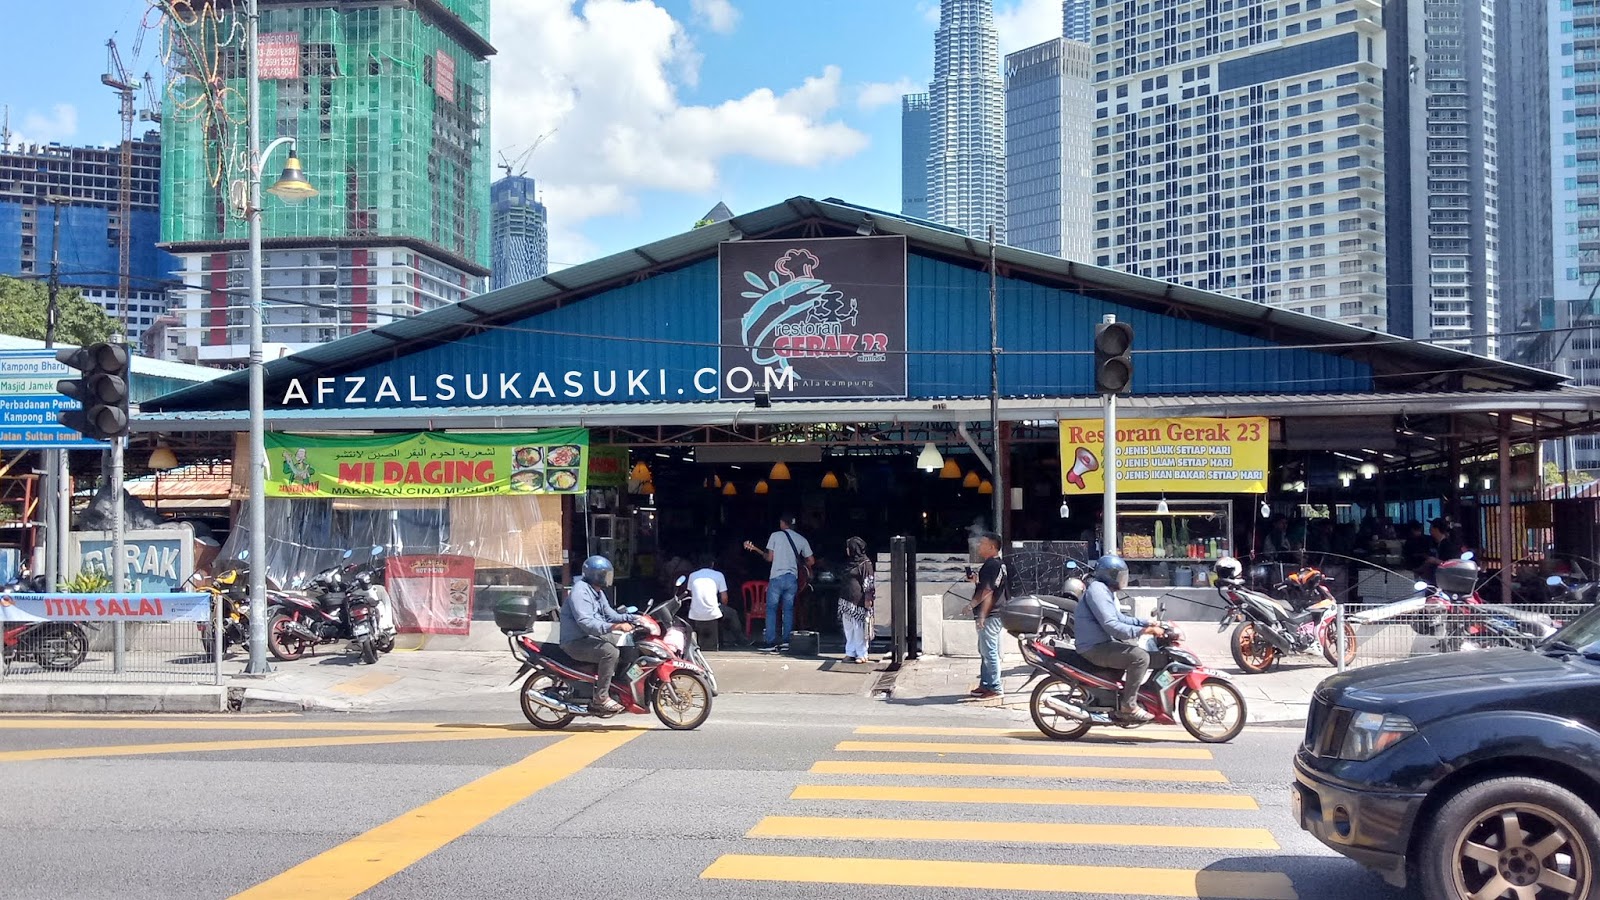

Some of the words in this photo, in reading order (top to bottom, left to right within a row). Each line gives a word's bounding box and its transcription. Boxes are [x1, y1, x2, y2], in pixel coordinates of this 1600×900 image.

[774, 321, 842, 336] restoran
[773, 335, 859, 358] GERAK
[861, 333, 889, 355] 23
[1, 362, 39, 373] Kampong
[41, 362, 65, 371] Bharu
[0, 381, 26, 392] Masjid
[28, 381, 54, 390] Jamek
[824, 380, 874, 388] Kampung
[0, 400, 50, 410] Perbadanan
[52, 400, 82, 409] Pemba
[4, 412, 43, 423] Kampong
[45, 412, 57, 422] Bh
[0, 431, 22, 441] Jalan
[25, 431, 54, 441] Sultan
[56, 431, 82, 441] Ismail
[1069, 426, 1161, 443] Resoran
[1166, 423, 1230, 442] Gerak
[1237, 422, 1261, 442] 23
[1124, 446, 1149, 456] JENIS
[1150, 445, 1174, 455] LAUK
[1175, 445, 1207, 455] SETIAP
[1208, 445, 1231, 455] HARI
[1124, 458, 1149, 468] JENIS
[1151, 457, 1176, 467] ULAM
[1177, 457, 1208, 467] SETIAP
[1210, 458, 1233, 467] HARI
[338, 461, 376, 485] MI
[383, 460, 495, 485] DAGING
[1124, 470, 1150, 480] JENIS
[1151, 470, 1172, 480] IKAN
[1174, 470, 1206, 480] BAKAR
[1207, 470, 1239, 480] SETIAP
[1240, 470, 1263, 480] HARI
[331, 487, 402, 496] MAKANAN
[406, 487, 441, 495] CINA
[44, 598, 91, 616] ITIK
[95, 597, 163, 616] SALAI
